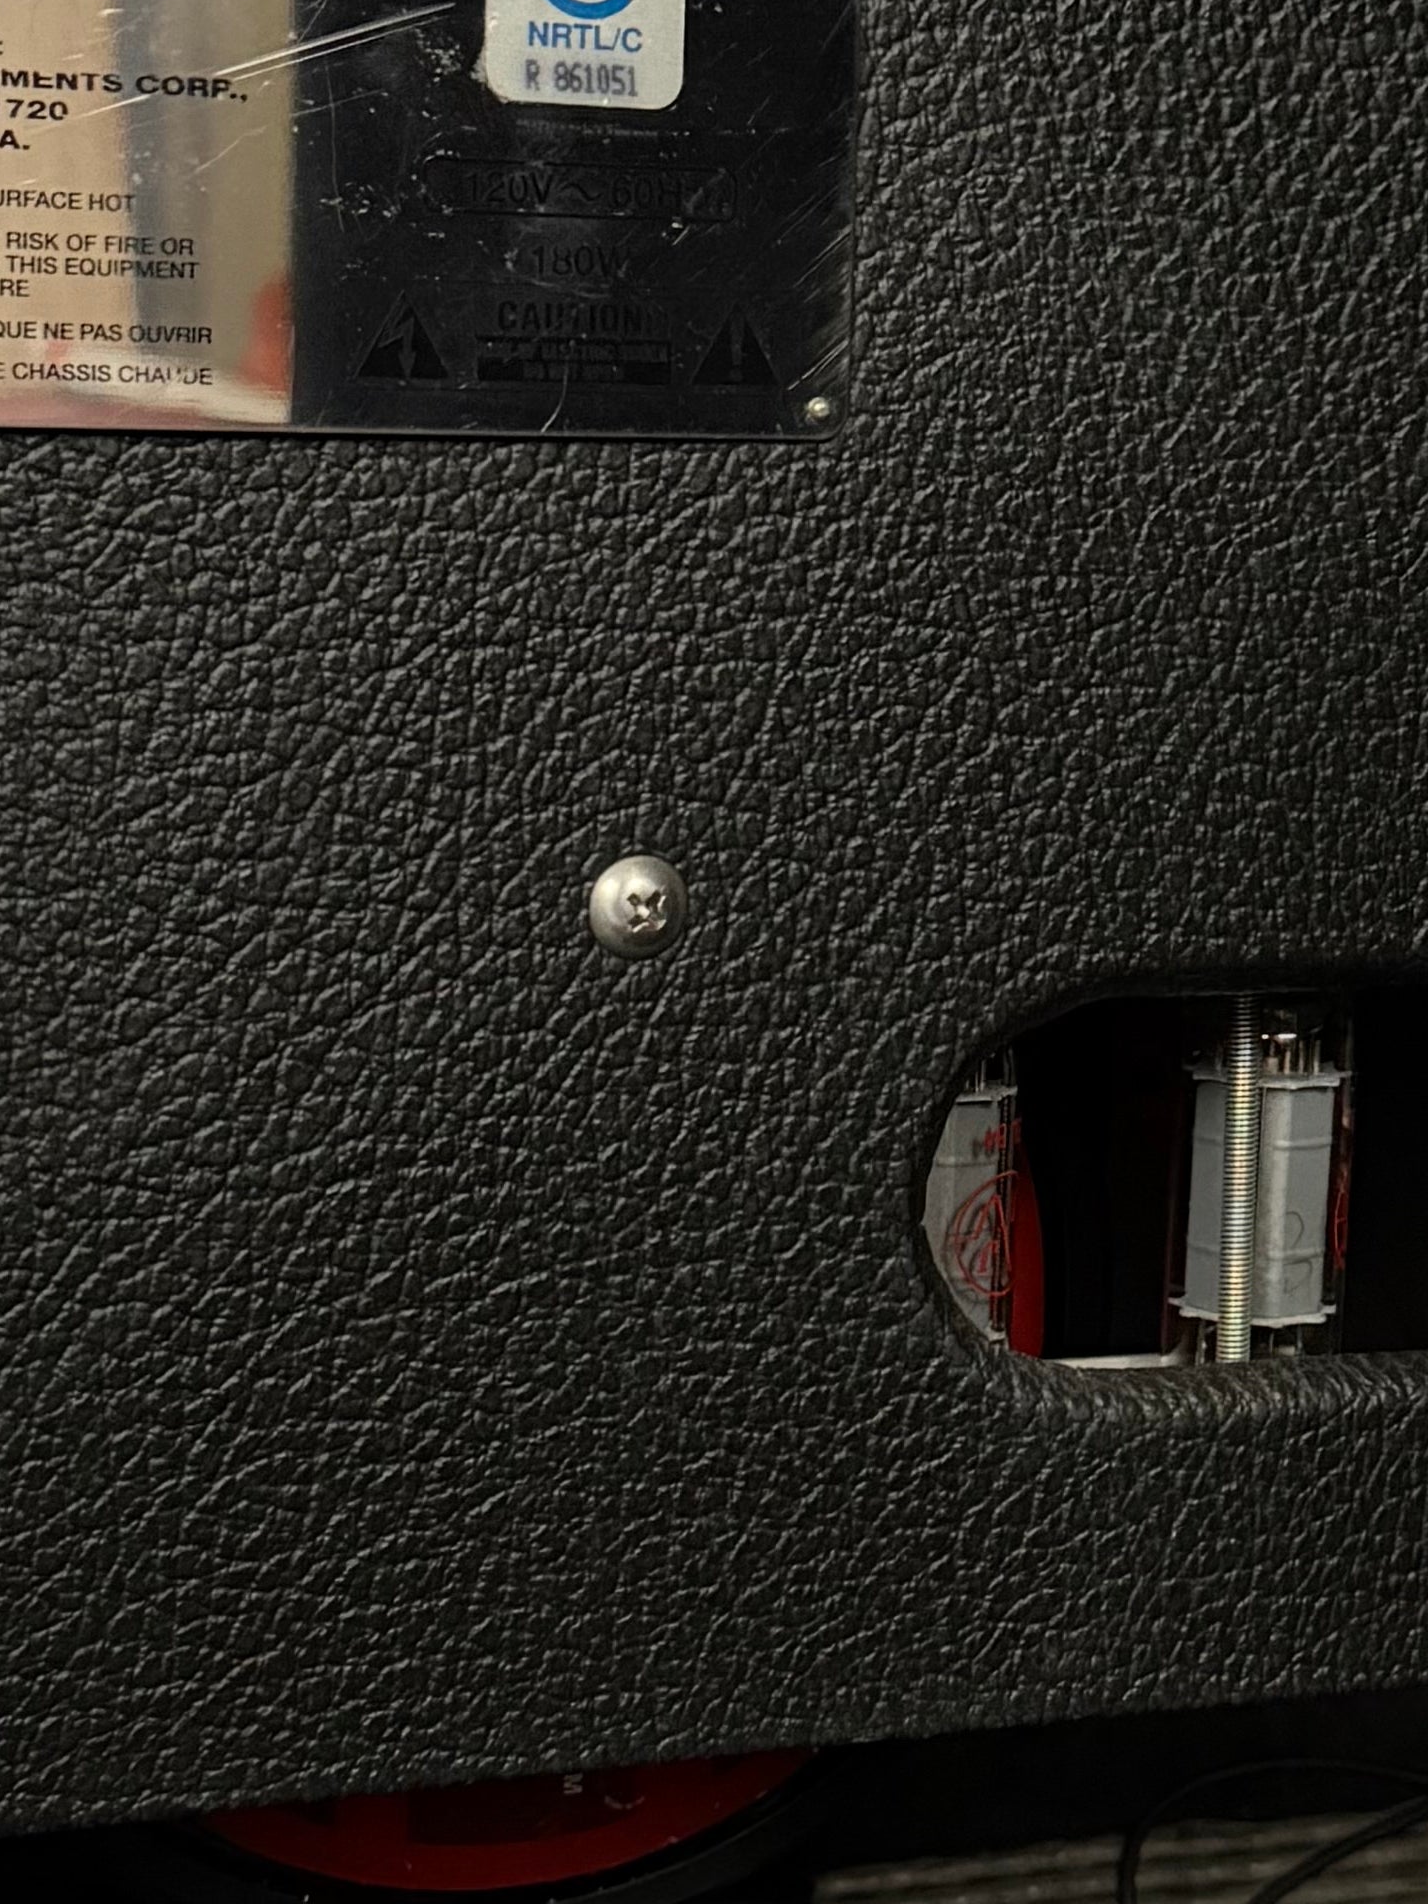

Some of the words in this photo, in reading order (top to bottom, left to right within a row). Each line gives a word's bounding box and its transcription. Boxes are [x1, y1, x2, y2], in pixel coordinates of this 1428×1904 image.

[527, 21, 644, 53] NRTL/C
[524, 59, 541, 92] R
[553, 61, 639, 97] 861051
[88, 192, 137, 213] HOT
[6, 230, 60, 252] RISK
[66, 233, 98, 253] OF
[104, 234, 155, 256] FIRE
[160, 237, 195, 257] OR
[5, 254, 59, 276] THIS
[64, 257, 201, 280] EQUIPMENT
[42, 322, 75, 341] NE
[80, 322, 123, 342] PAS
[128, 323, 213, 346] OUVRIR
[11, 361, 113, 385] CHASSIS
